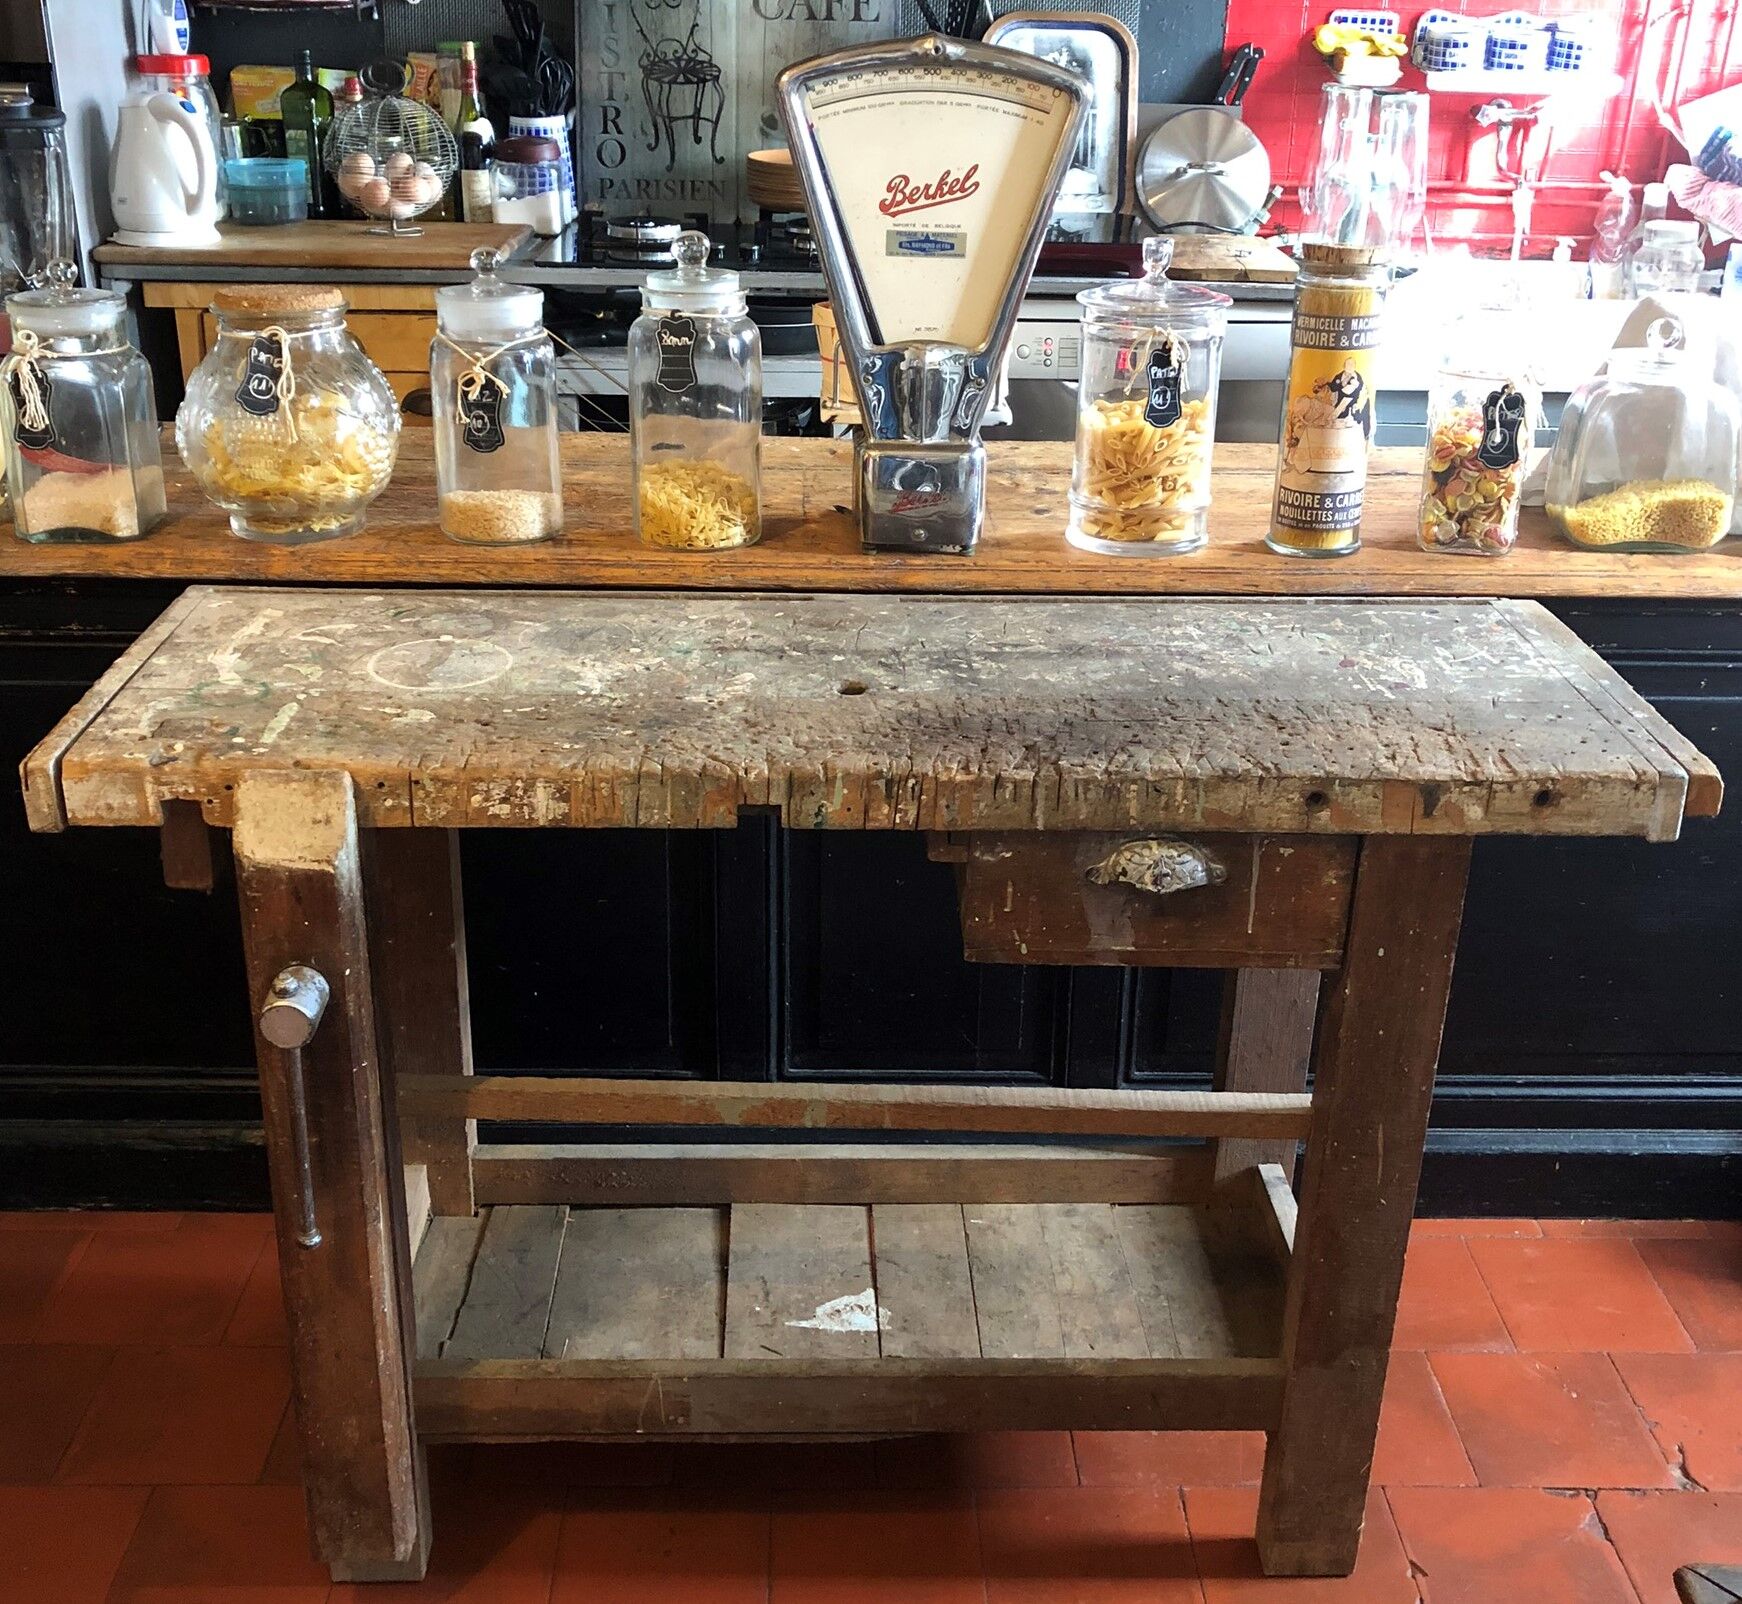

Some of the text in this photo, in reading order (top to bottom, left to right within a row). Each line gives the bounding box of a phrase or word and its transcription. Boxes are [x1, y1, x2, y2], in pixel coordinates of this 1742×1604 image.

[823, 78, 839, 88] 900
[873, 69, 888, 77] 700
[923, 67, 942, 76] 500
[951, 68, 967, 76] 400
[976, 71, 992, 80] 300
[1001, 76, 1017, 85] 200
[1027, 82, 1040, 91] 100
[1052, 87, 1061, 98] 0
[598, 177, 727, 201] PARISIEN
[879, 163, 980, 218] Berkel
[1297, 315, 1346, 331] VERMICELLE
[1294, 329, 1337, 347] RIVOIRE
[1340, 335, 1350, 347] &
[1279, 488, 1321, 509] RIVOIRE
[1324, 497, 1334, 509] &
[1279, 504, 1333, 522] NOUILLETTES
